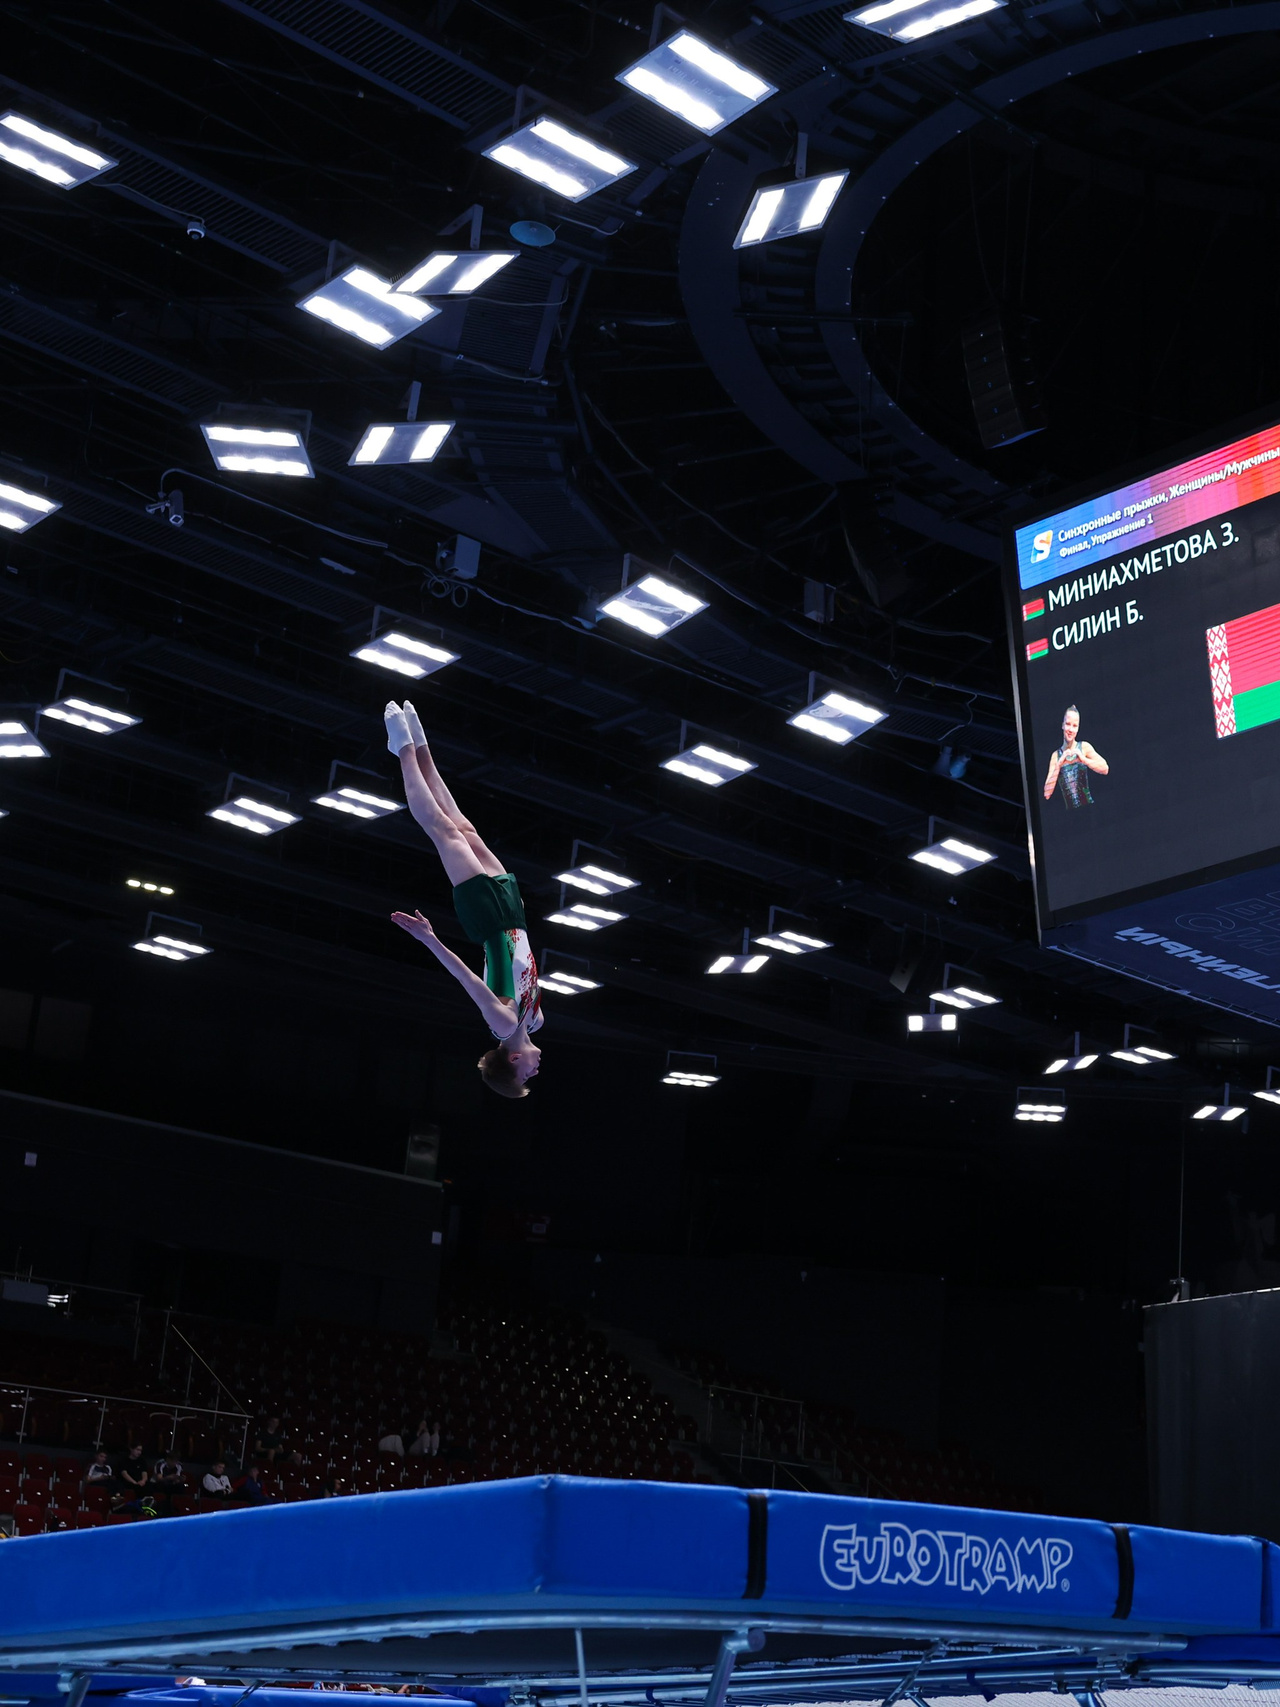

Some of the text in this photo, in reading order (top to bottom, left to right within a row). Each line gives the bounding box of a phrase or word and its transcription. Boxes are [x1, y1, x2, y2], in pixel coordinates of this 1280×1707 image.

[1058, 447, 1280, 542] Синхронные прыжки, Женщины/Мужчины
[1048, 522, 1240, 611] МИНИАХМЕТОВА З.
[1059, 513, 1153, 558] Финал, Упражнение 1
[1052, 600, 1144, 650] СИЛИН Б.
